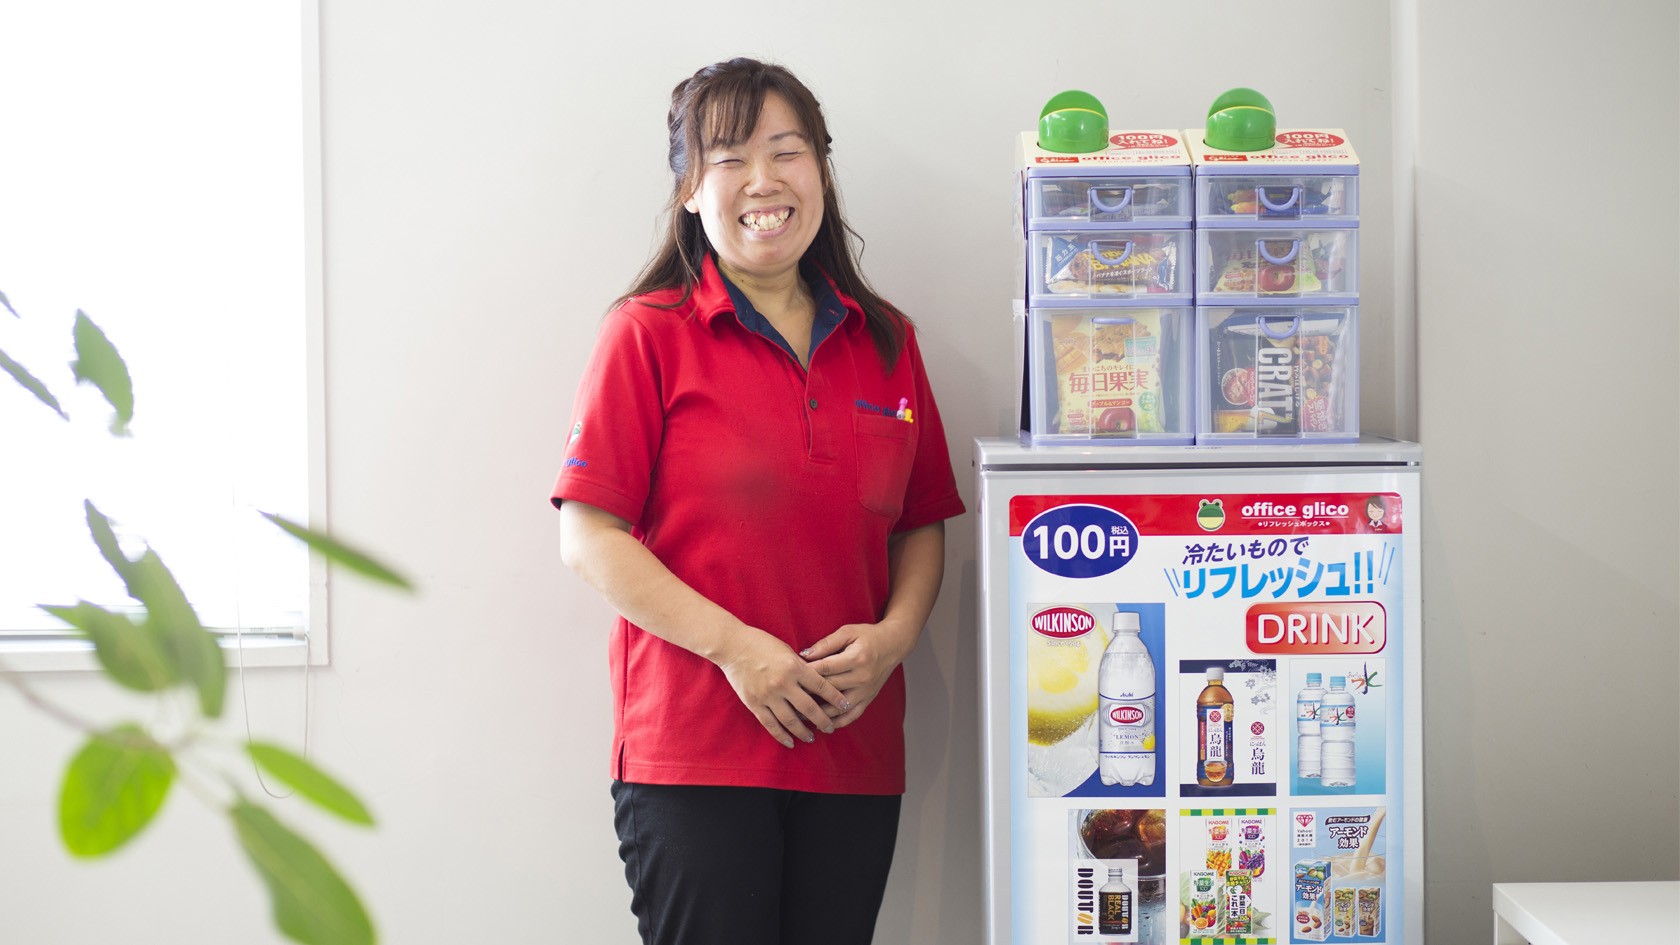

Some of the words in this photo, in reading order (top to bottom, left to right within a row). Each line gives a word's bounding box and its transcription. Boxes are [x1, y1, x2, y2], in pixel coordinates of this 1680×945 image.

[1069, 368, 1149, 394] 毎日果実
[1241, 502, 1297, 517] office
[1302, 502, 1349, 518] glico
[1110, 525, 1129, 535] 税込
[1182, 536, 1310, 566] 冷たいもので
[1034, 612, 1092, 633] WILKINSON
[1258, 613, 1375, 645] DRINK
[1111, 709, 1143, 721] WILKINSON
[1329, 826, 1369, 839] アーモンド
[1338, 837, 1360, 849] 効果
[1295, 884, 1324, 894] アーモンド
[1077, 868, 1094, 935] DOUTOR
[1231, 895, 1239, 917] これ一本
